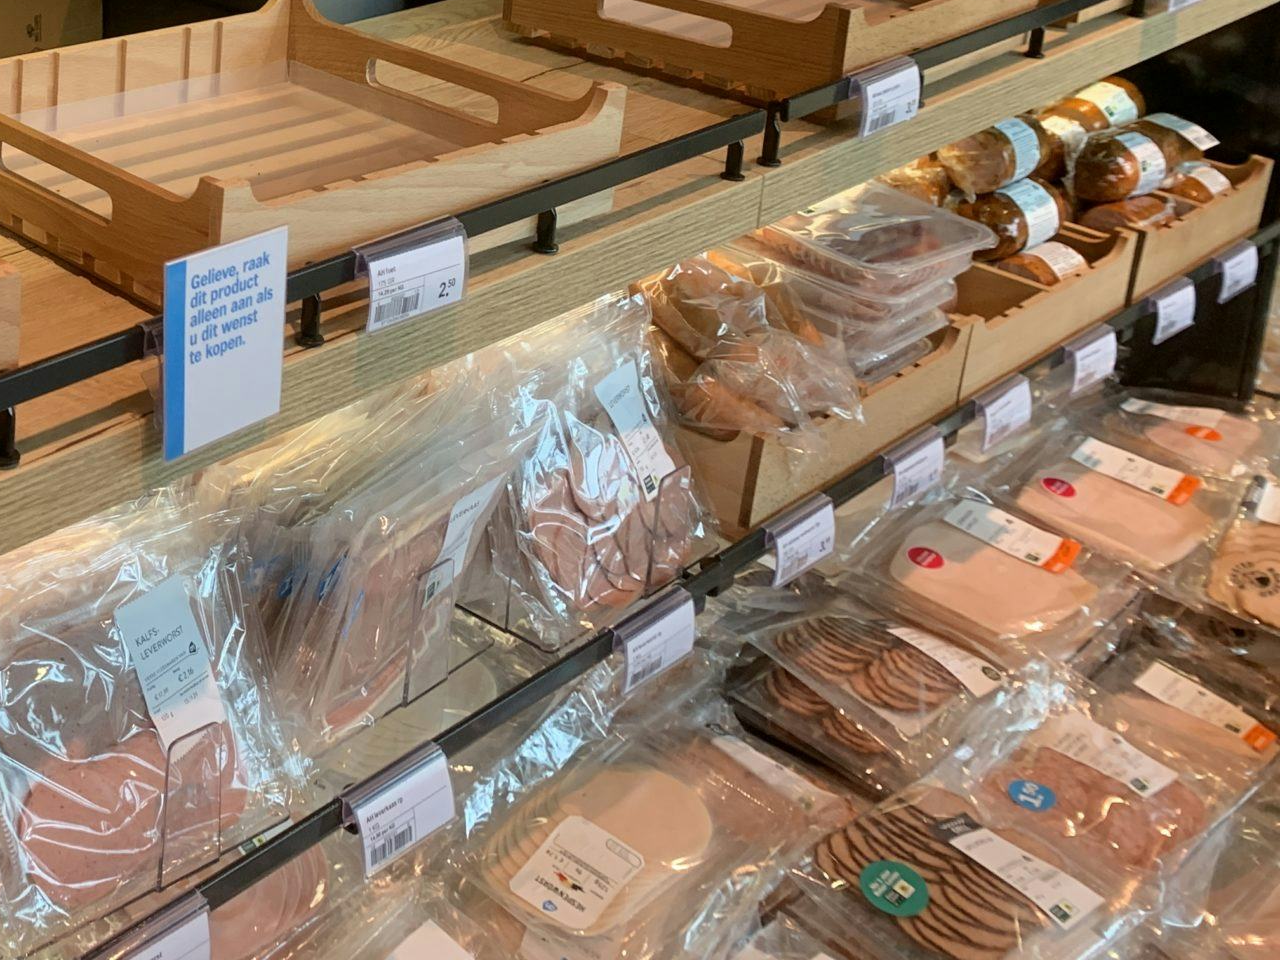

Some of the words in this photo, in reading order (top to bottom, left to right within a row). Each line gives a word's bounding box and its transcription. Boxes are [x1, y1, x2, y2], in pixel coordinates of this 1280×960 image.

[242, 251, 271, 274] raak
[190, 290, 208, 309] dit
[211, 274, 260, 304] product
[190, 303, 228, 328] alleen
[231, 296, 254, 312] aan
[256, 287, 274, 306] als
[190, 335, 198, 347] u
[201, 323, 219, 343] dit
[221, 310, 258, 335] wenst
[189, 349, 202, 365] te
[205, 334, 247, 360] kopen.
